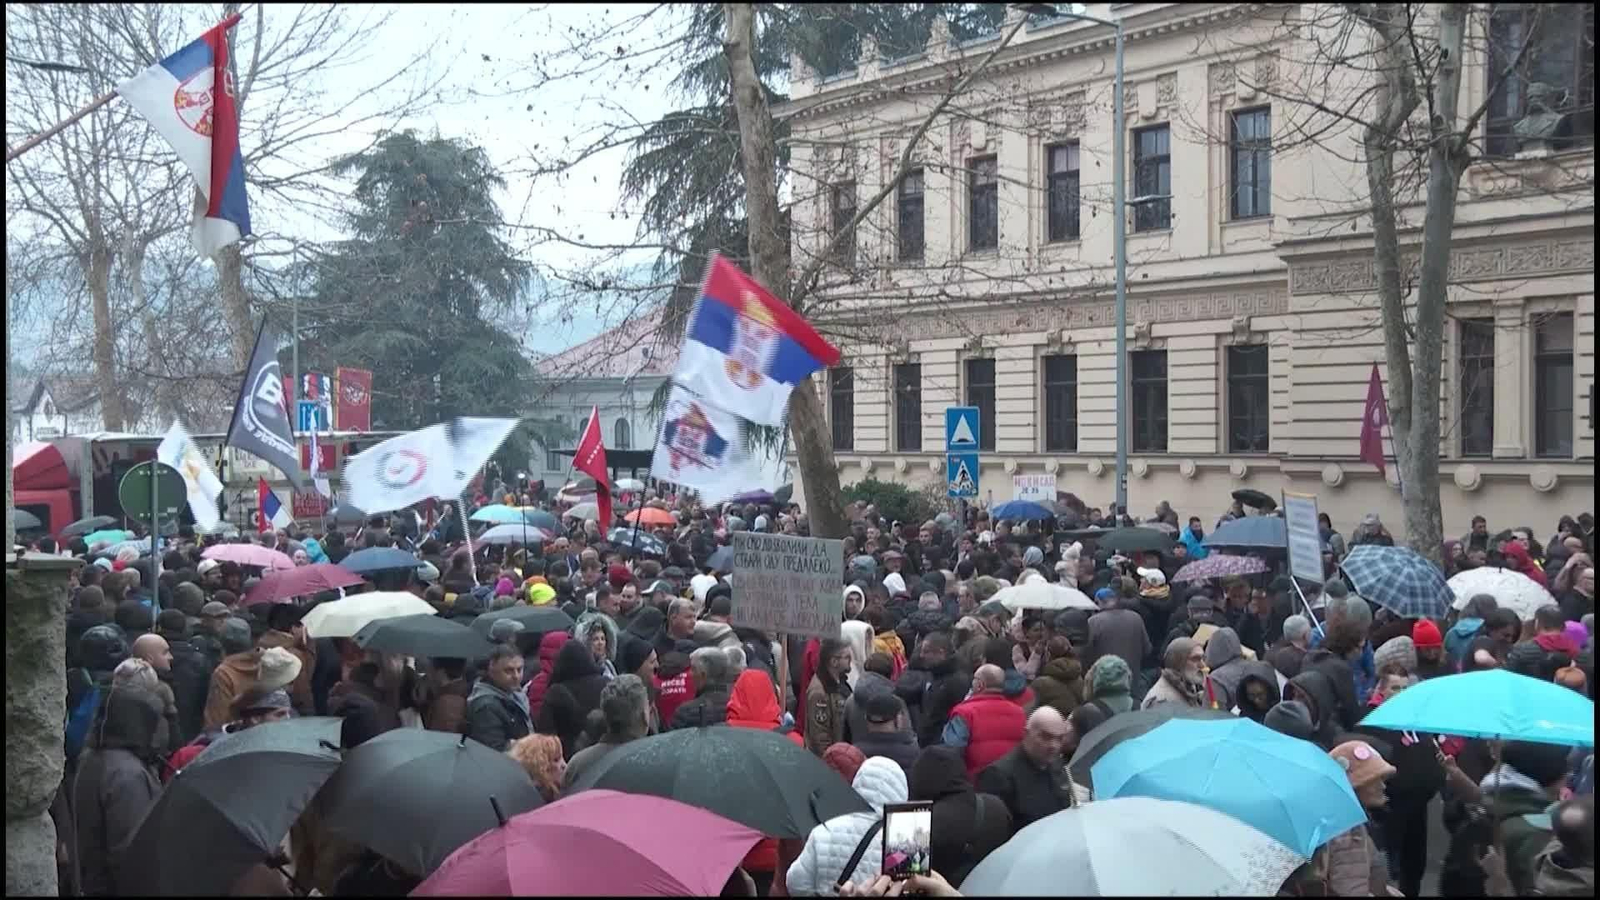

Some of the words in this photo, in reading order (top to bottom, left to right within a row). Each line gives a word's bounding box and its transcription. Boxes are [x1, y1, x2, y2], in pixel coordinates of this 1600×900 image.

[746, 536, 762, 551] СМО
[762, 537, 808, 556] ДОЗВОЛИЛИ
[811, 541, 828, 558] ДА
[734, 552, 762, 569] СТВАРИ
[764, 554, 780, 570] ОДУ
